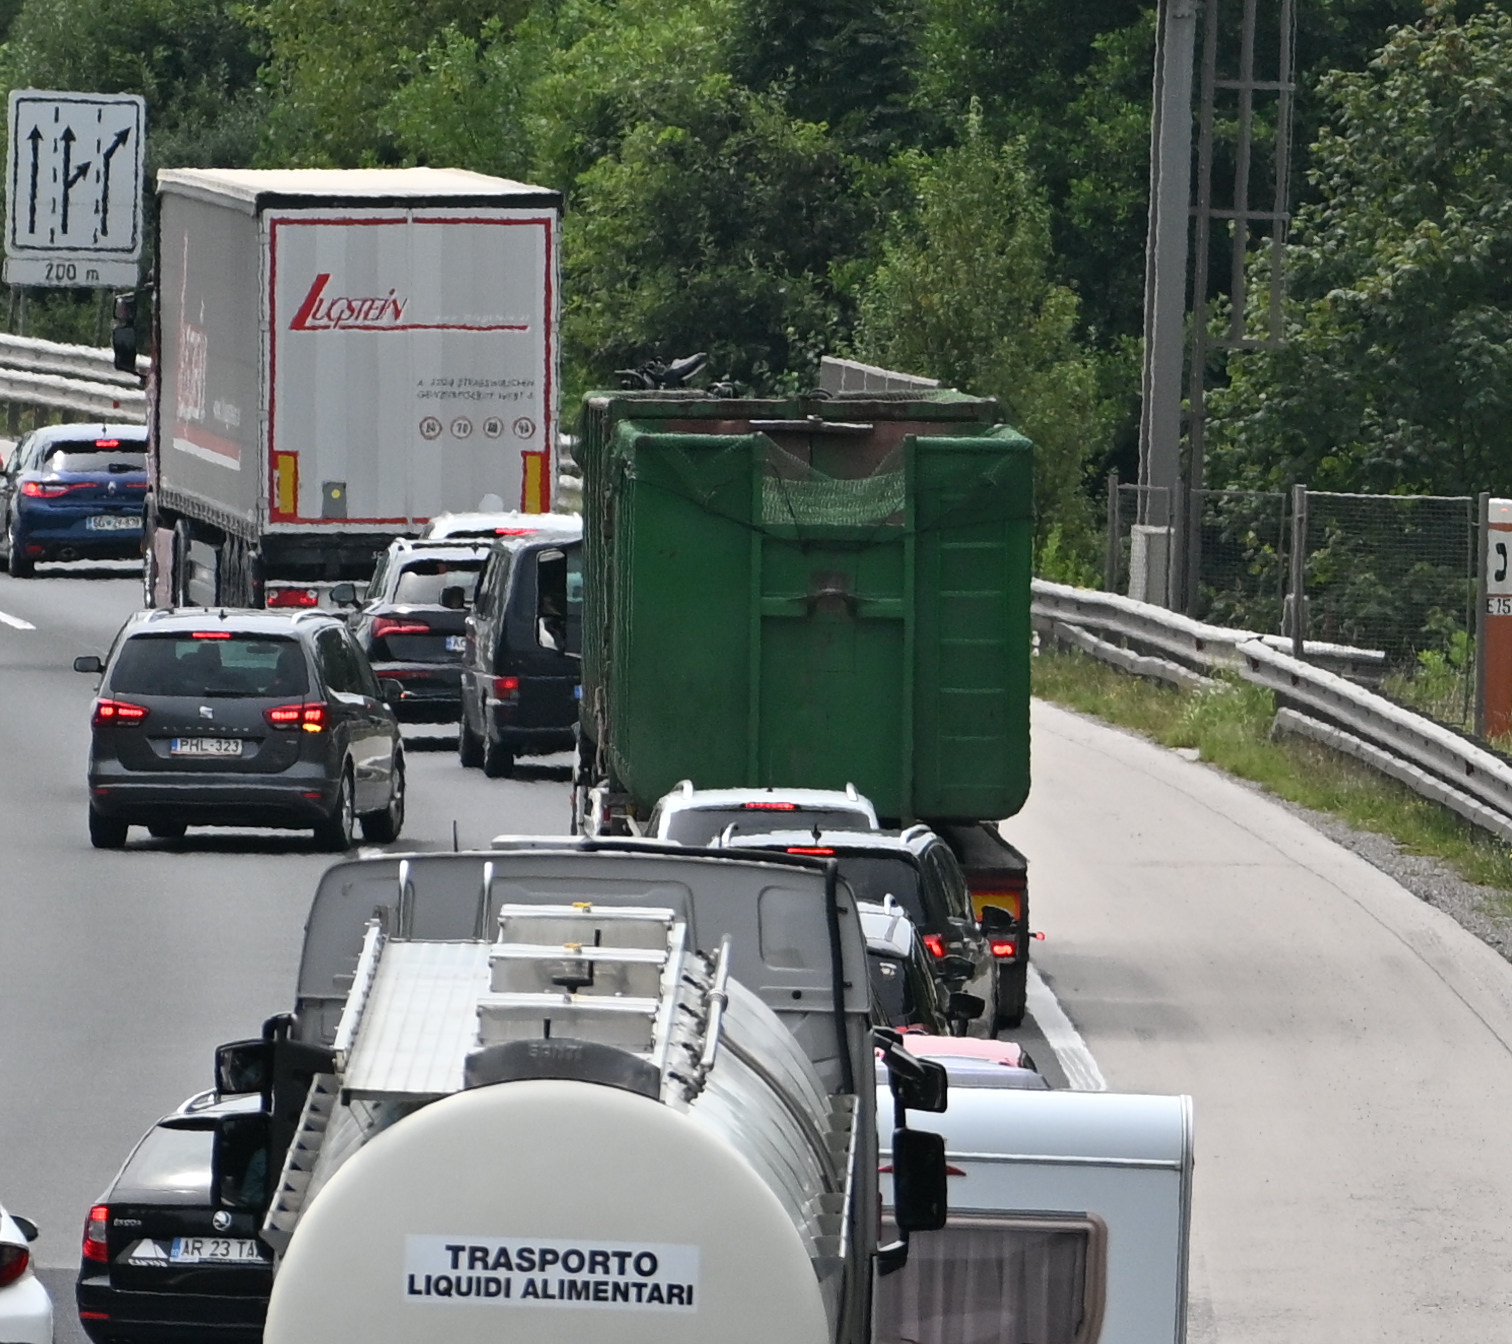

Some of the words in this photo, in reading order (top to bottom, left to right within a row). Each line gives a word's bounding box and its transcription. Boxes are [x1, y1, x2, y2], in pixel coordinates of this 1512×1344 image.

[45, 262, 77, 283] 200
[85, 268, 100, 283] m
[1486, 598, 1511, 614] E15
[179, 739, 240, 754] PHL-323
[181, 1239, 203, 1257] AR
[211, 1240, 231, 1257] 23
[239, 1241, 262, 1258] TA
[445, 1244, 659, 1277] TRASPORTO
[407, 1273, 513, 1300] LIQUIDI
[521, 1277, 694, 1306] ALIMENTARI
